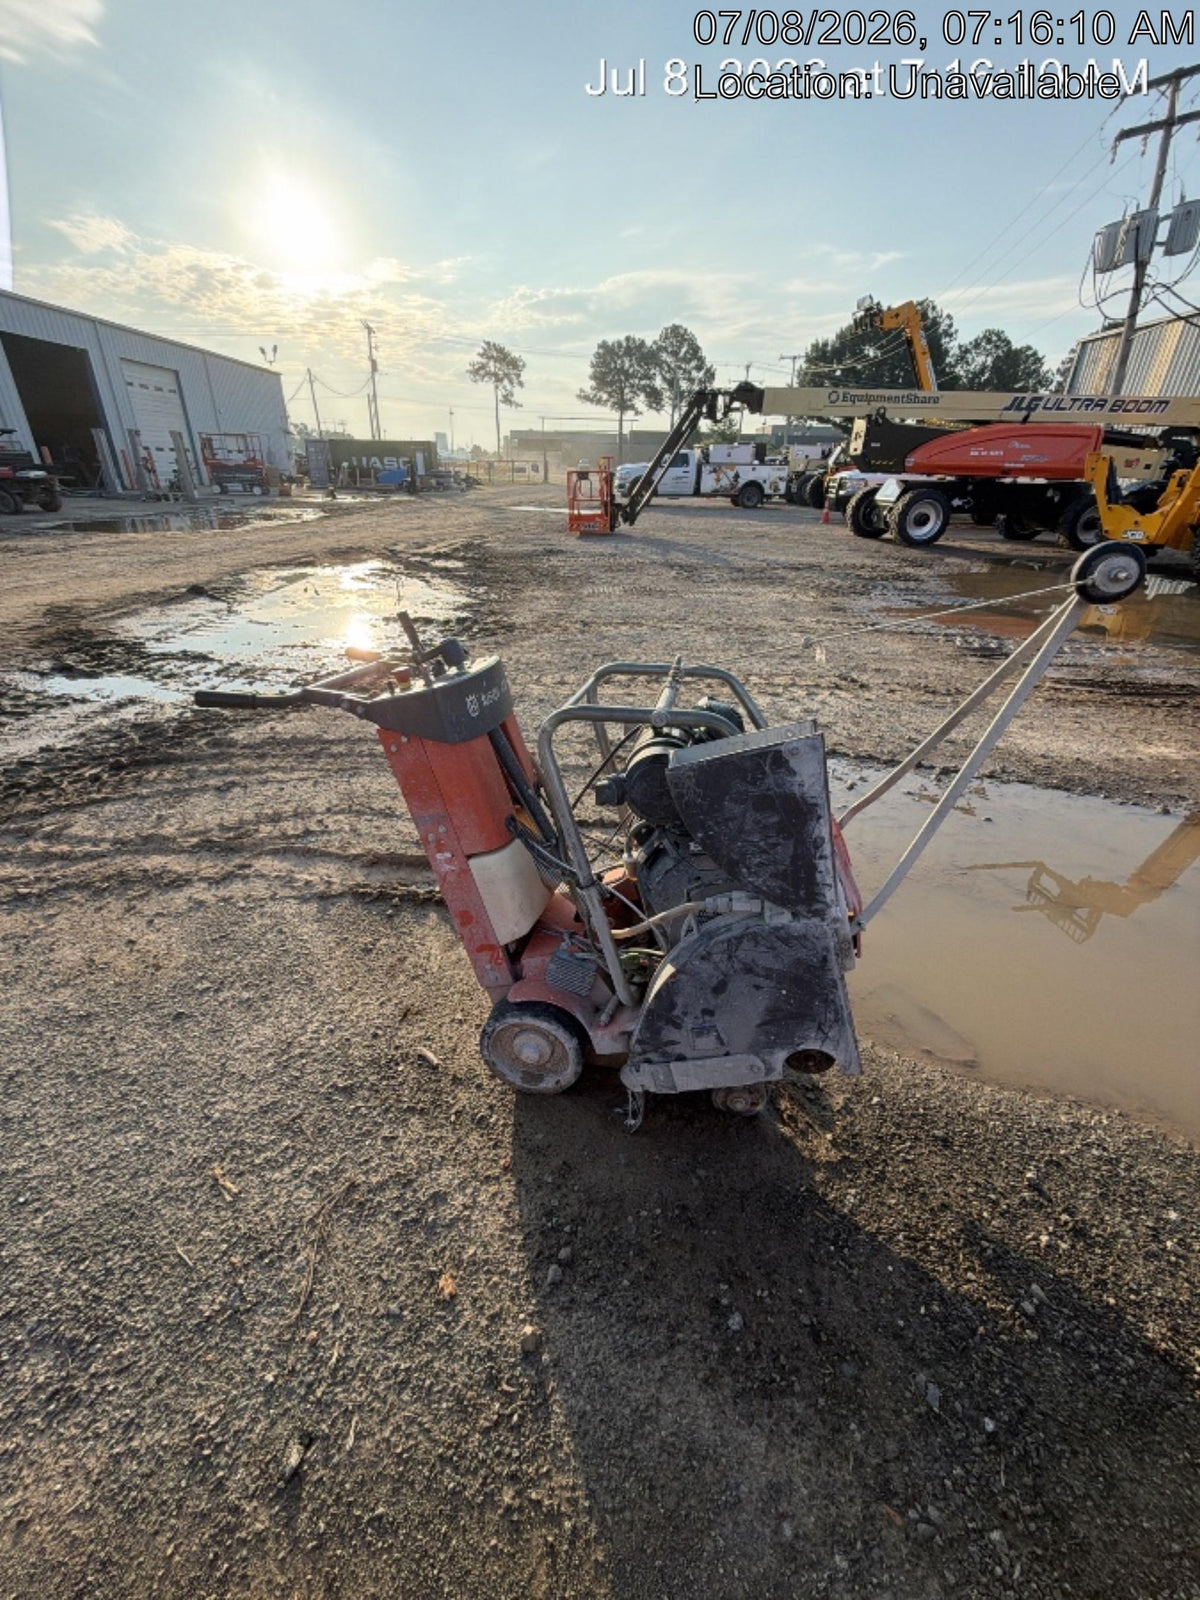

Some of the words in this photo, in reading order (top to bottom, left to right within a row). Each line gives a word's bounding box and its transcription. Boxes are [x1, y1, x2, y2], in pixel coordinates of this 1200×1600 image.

[841, 390, 941, 406] EquipmentShare
[1002, 396, 1043, 413] JLG
[1042, 397, 1109, 412] ULTRA
[1108, 399, 1172, 414] BOOM
